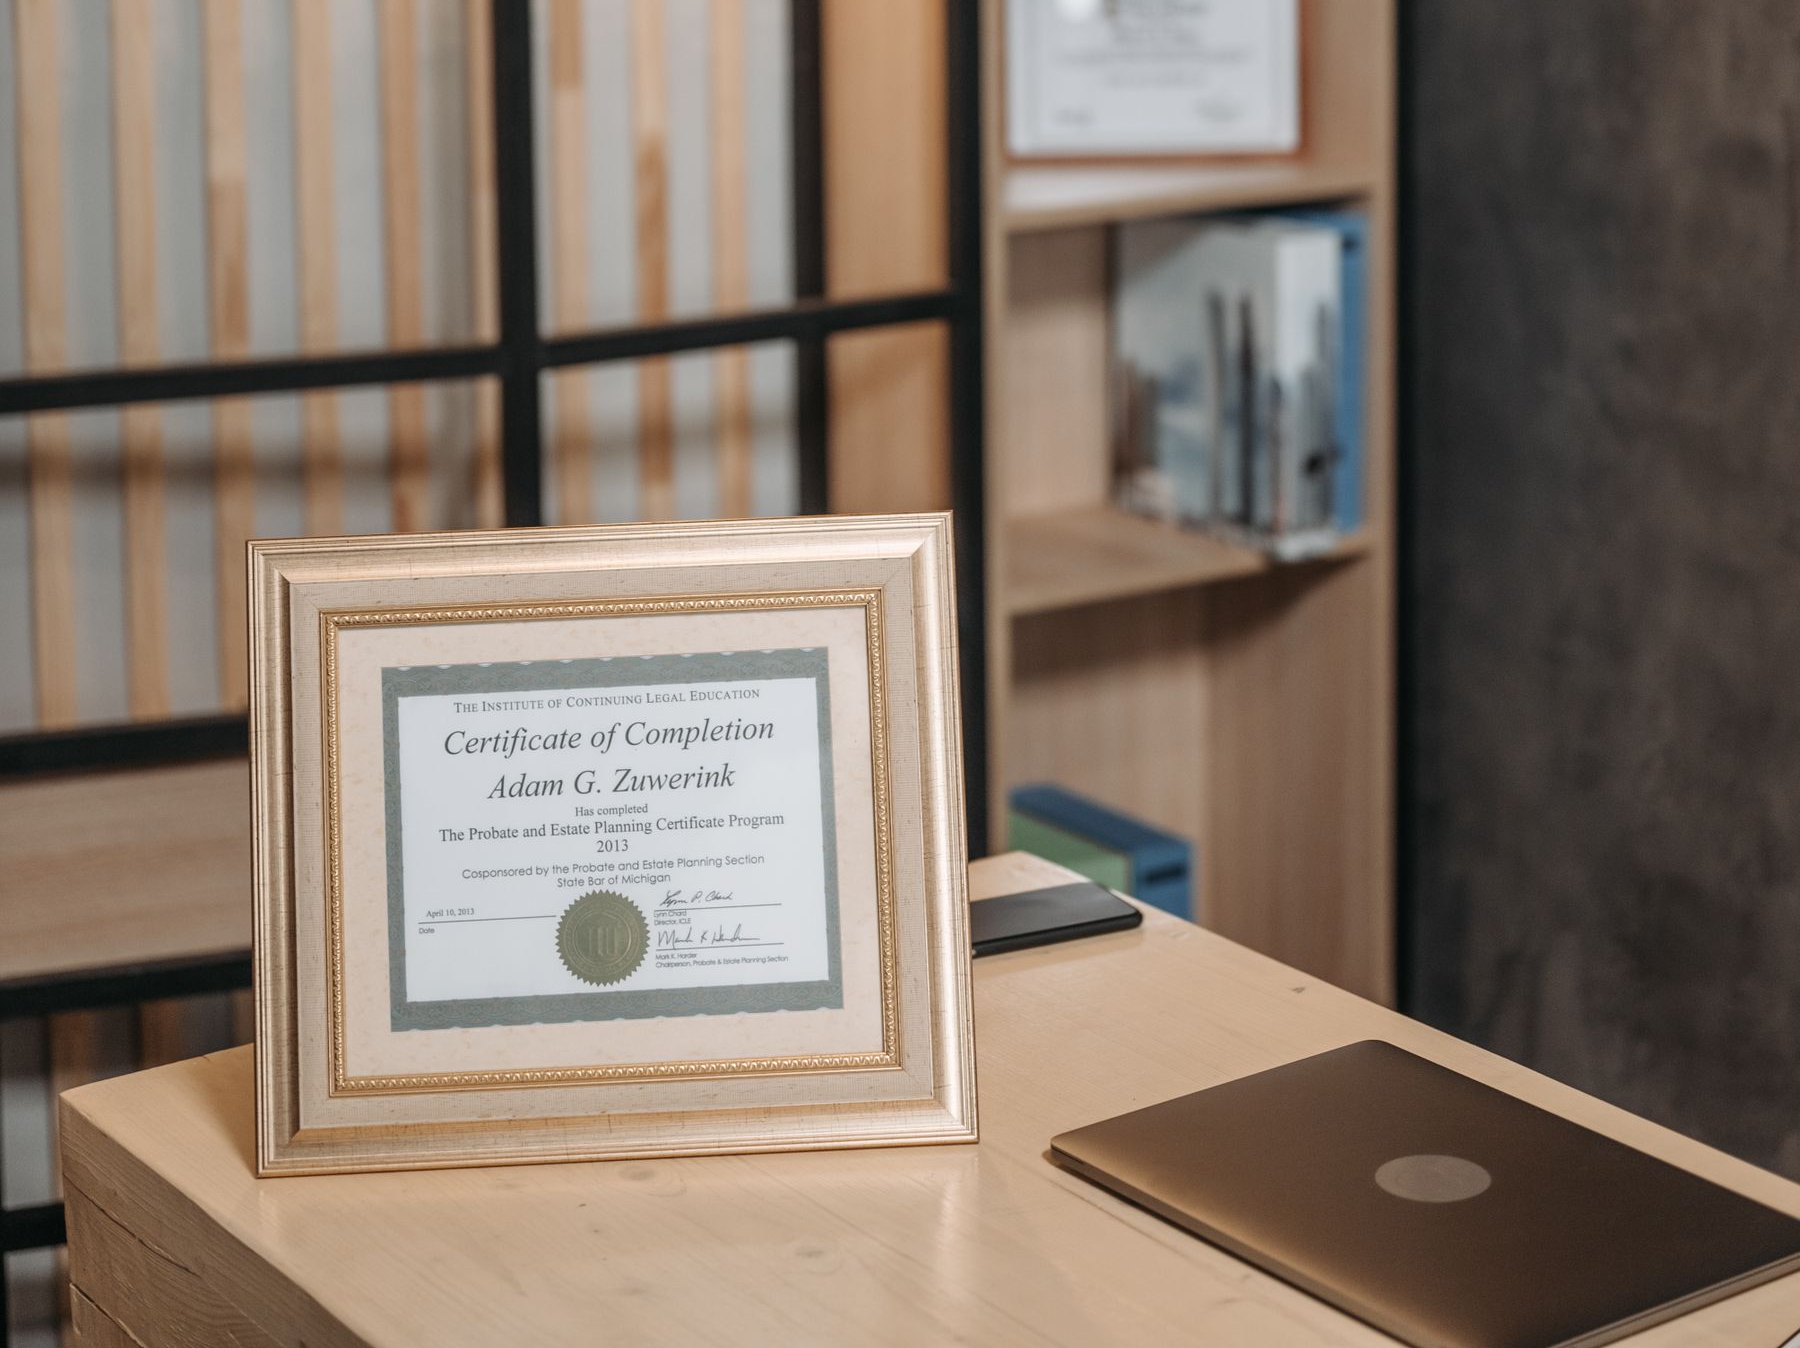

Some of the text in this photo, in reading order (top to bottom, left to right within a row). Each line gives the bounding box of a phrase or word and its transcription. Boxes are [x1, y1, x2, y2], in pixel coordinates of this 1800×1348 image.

[454, 702, 478, 714] THE
[482, 700, 544, 712] INSTITUTE
[566, 695, 642, 708] CONTINUING
[646, 692, 686, 704] LEGAL
[690, 689, 760, 701] EDUCATION
[445, 718, 774, 759] Certificate of Completion
[487, 763, 736, 799] Adam G. Zuwerink
[575, 803, 648, 817] Has completed
[439, 814, 784, 842] The Probate and Estate Planning Certificate Program
[597, 840, 628, 852] 2013
[462, 854, 765, 880] Cosponsored by the Probate and Estate Planning Section
[557, 873, 671, 888] State Bar of Michigan
[426, 910, 444, 918] April
[458, 908, 475, 916] 2013
[741, 957, 766, 965] Planning
